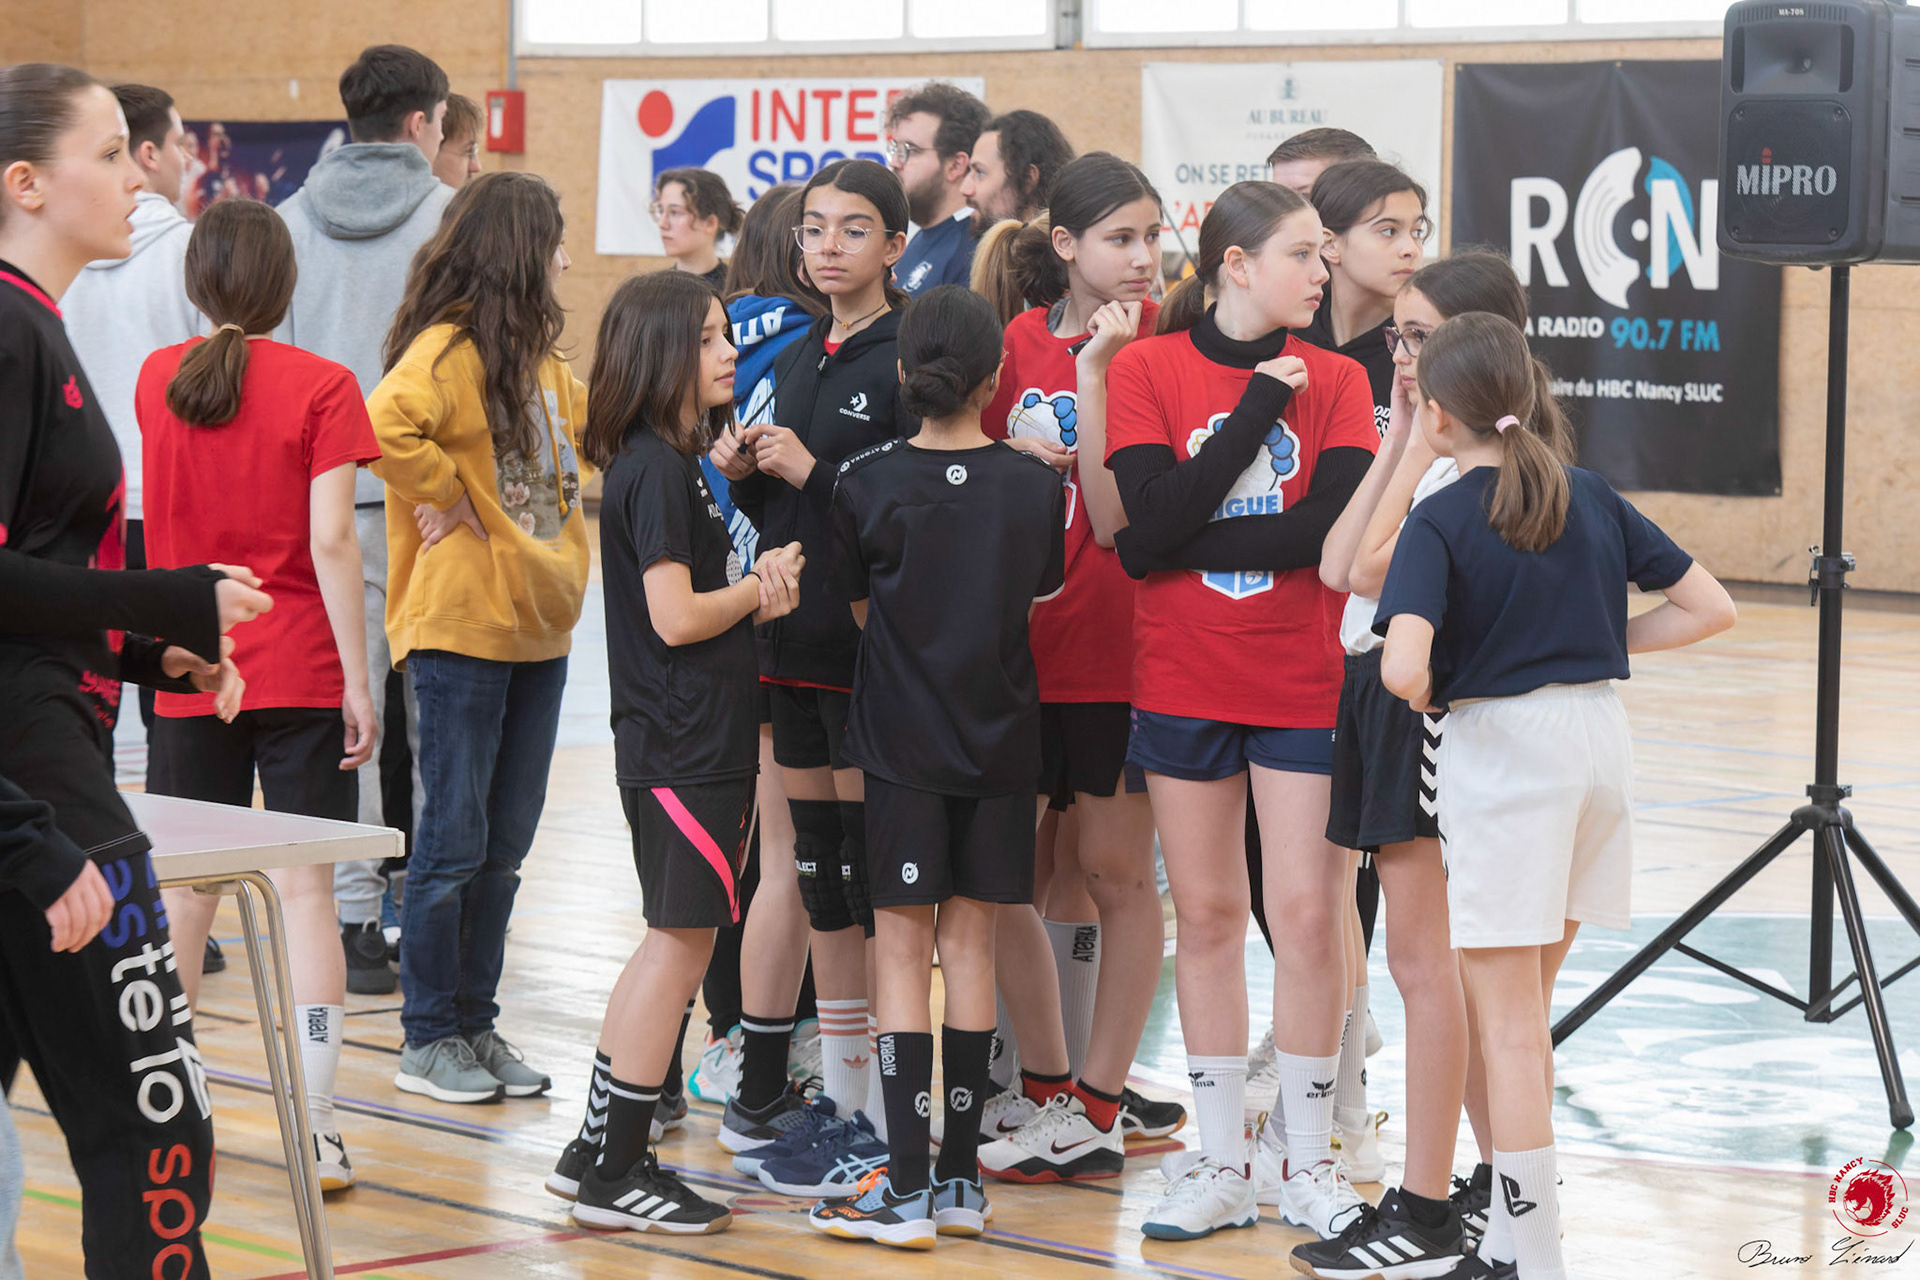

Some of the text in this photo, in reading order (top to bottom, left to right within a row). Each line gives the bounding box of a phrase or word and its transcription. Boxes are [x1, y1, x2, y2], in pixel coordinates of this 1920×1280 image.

[751, 89, 910, 142] INTE
[1269, 109, 1328, 124] BUREAU
[748, 150, 888, 200] SP
[1175, 164, 1204, 184] ON
[1208, 164, 1230, 184] SE
[1537, 316, 1605, 338] RADIO
[1610, 316, 1674, 350] 90.7
[1680, 319, 1721, 352] FM
[1575, 377, 1594, 397] du
[1596, 379, 1634, 399] HBC
[1635, 381, 1682, 405] Nancy
[1684, 382, 1724, 403] SLUC
[839, 407, 870, 421] CONVERSE
[1210, 494, 1279, 519] IGUE
